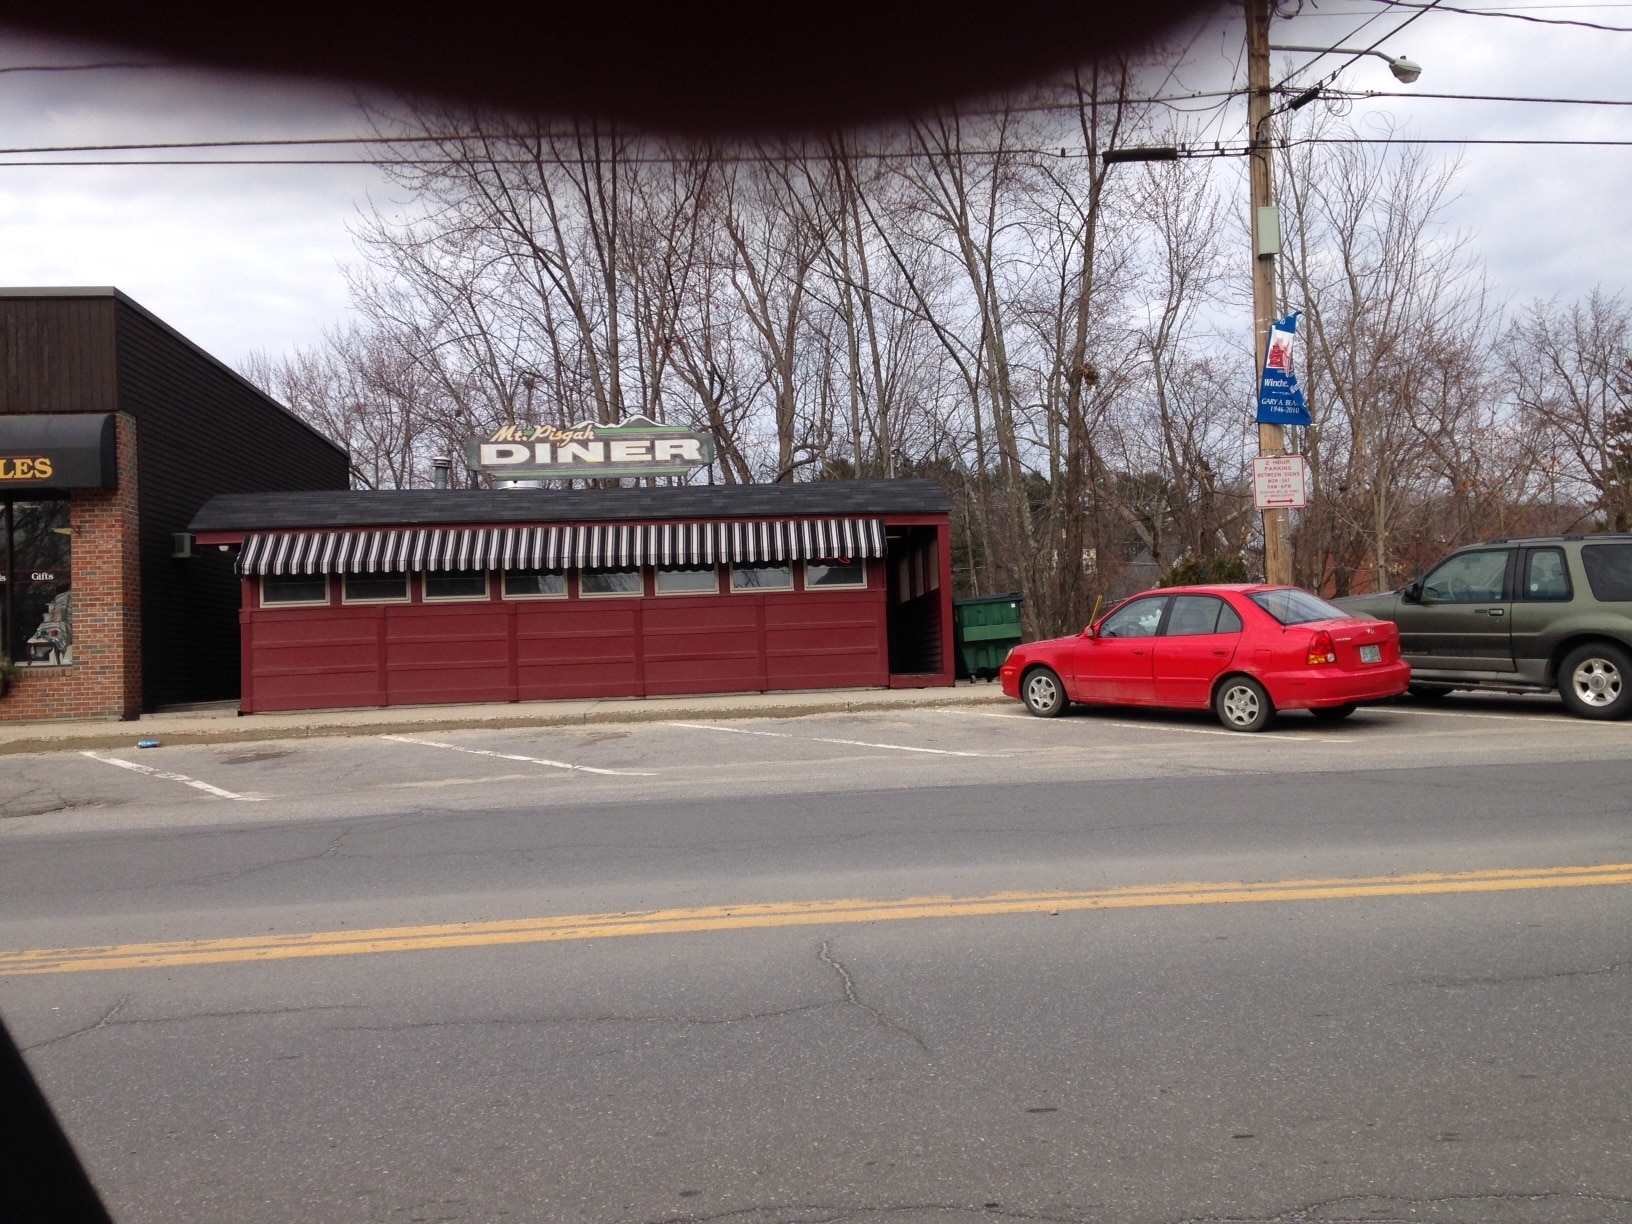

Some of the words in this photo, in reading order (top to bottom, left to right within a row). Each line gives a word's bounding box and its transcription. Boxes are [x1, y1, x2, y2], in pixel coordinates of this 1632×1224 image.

[1261, 397, 1278, 405] GARY
[489, 425, 527, 442] Mt.
[528, 424, 595, 448] Pisgah
[480, 438, 702, 465] DINER
[31, 571, 54, 581] Gifts
